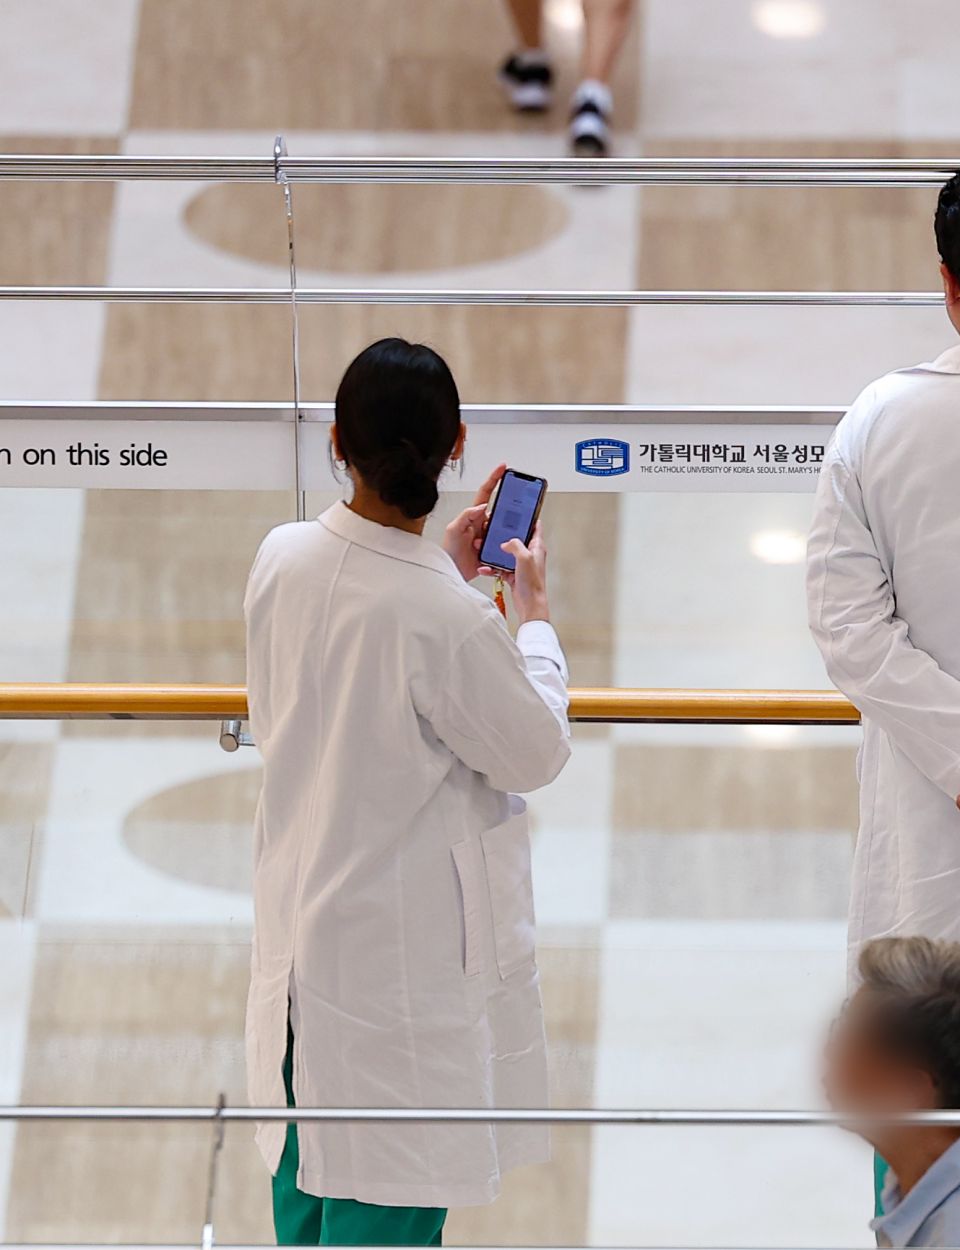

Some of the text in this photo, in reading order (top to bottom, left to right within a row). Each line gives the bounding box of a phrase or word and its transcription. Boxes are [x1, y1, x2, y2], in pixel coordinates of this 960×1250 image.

[22, 448, 56, 466] on
[66, 442, 110, 466] this
[119, 443, 168, 466] side
[639, 443, 747, 463] 가톨릭대학교
[640, 465, 653, 474] THE
[653, 465, 686, 474] CATHOLIC
[686, 465, 723, 474] UNIVERSITY
[723, 466, 732, 474] OF
[732, 466, 755, 474] KOREA
[757, 466, 777, 474] SEOUL
[788, 466, 813, 474] MARY'S
